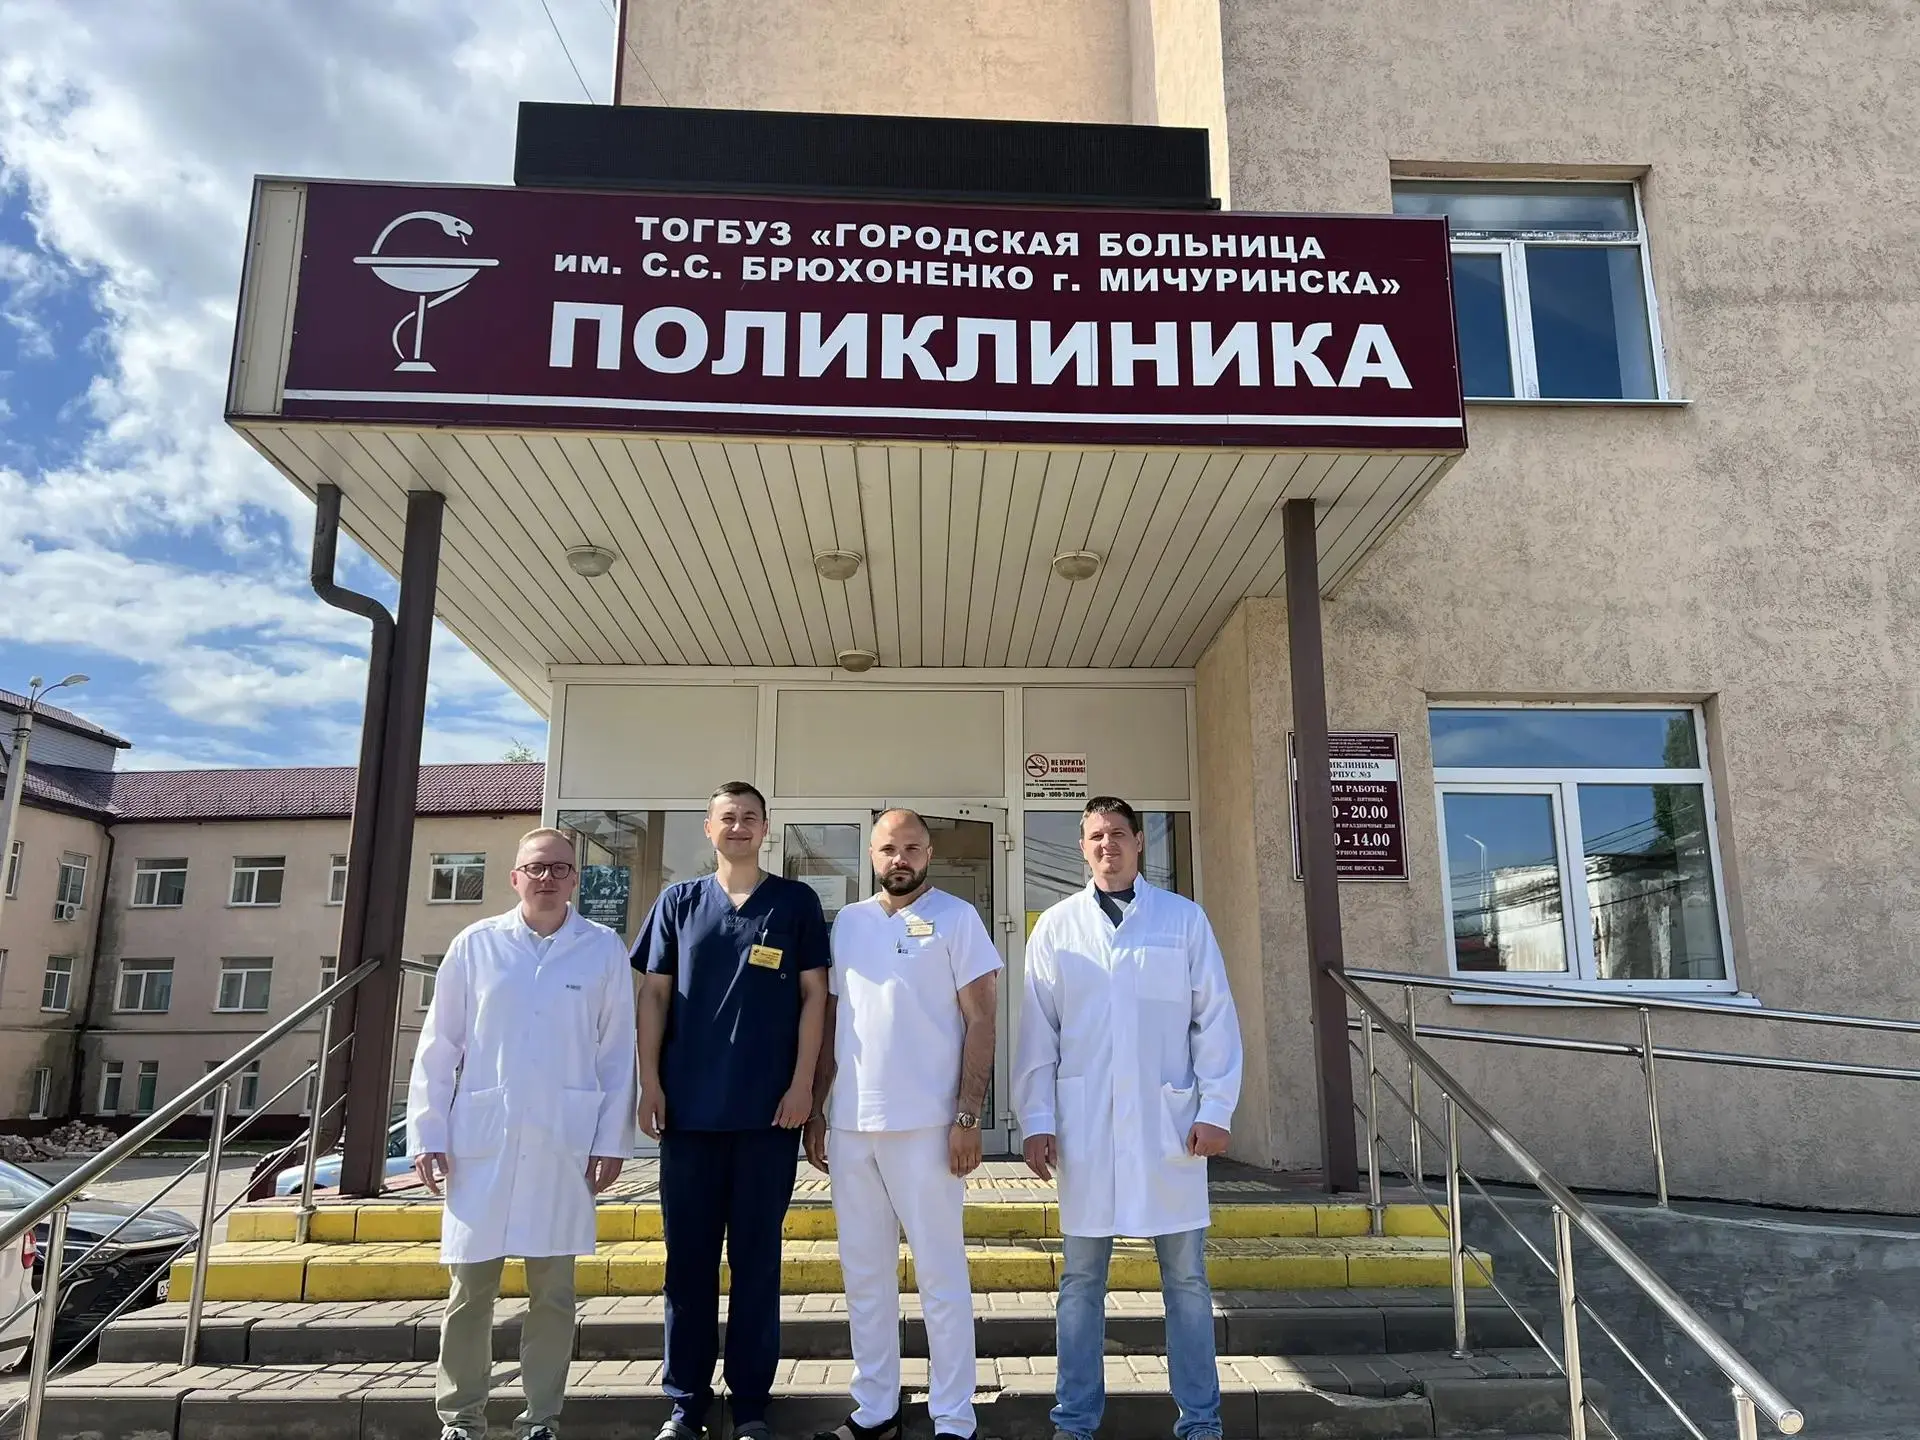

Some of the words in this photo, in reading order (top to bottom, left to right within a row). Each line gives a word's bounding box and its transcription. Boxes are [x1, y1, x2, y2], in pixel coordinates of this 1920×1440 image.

[634, 216, 792, 246] ТОГБУЗ
[810, 222, 1080, 257] «ГОРОДСКАЯ
[1099, 232, 1326, 263] БОЛЬНИЦА
[553, 254, 622, 275] им.
[641, 252, 722, 280] С.С.
[741, 255, 1034, 289] БРЮХОНЕНКО
[1052, 272, 1081, 291] г.
[1099, 267, 1401, 295] МИЧУРИНСКА»
[548, 300, 1413, 389] ПОЛИКЛИНИКА
[1346, 785, 1388, 793] РАБОТЫ:
[1351, 805, 1388, 819] 20.00
[1352, 832, 1391, 847] 14.00
